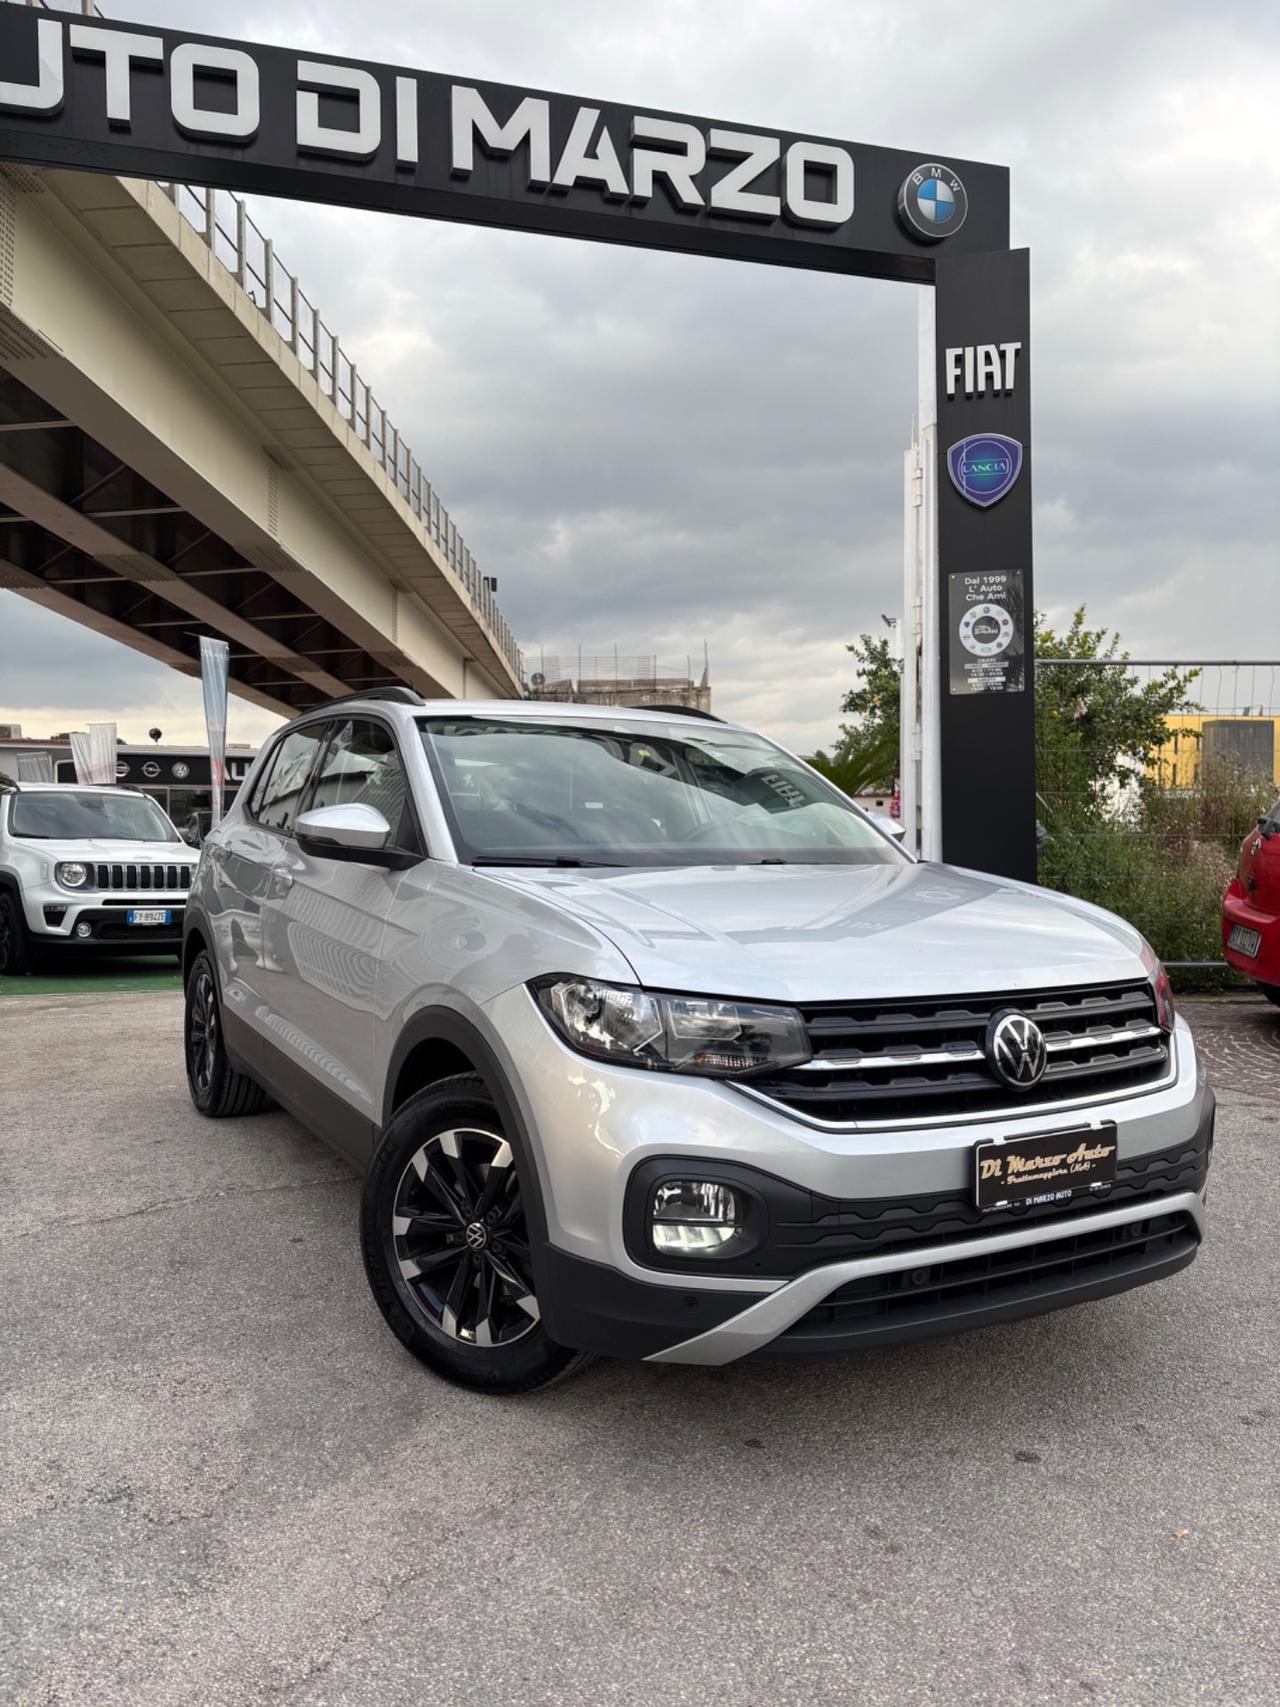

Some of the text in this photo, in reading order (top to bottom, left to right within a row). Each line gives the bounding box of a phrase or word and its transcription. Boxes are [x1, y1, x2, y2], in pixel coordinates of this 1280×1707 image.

[296, 60, 418, 166] DI
[451, 84, 855, 226] MARZO
[912, 167, 960, 192] BMW
[946, 341, 1022, 395] FIAT
[963, 462, 1006, 474] LANCIA
[965, 576, 979, 585] Dal
[980, 584, 1003, 592] Auto
[965, 591, 1006, 601] Che Ami
[980, 1143, 1116, 1179] Di Marzo Auto
[1026, 1189, 1073, 1206] DI MARZO AUTO
